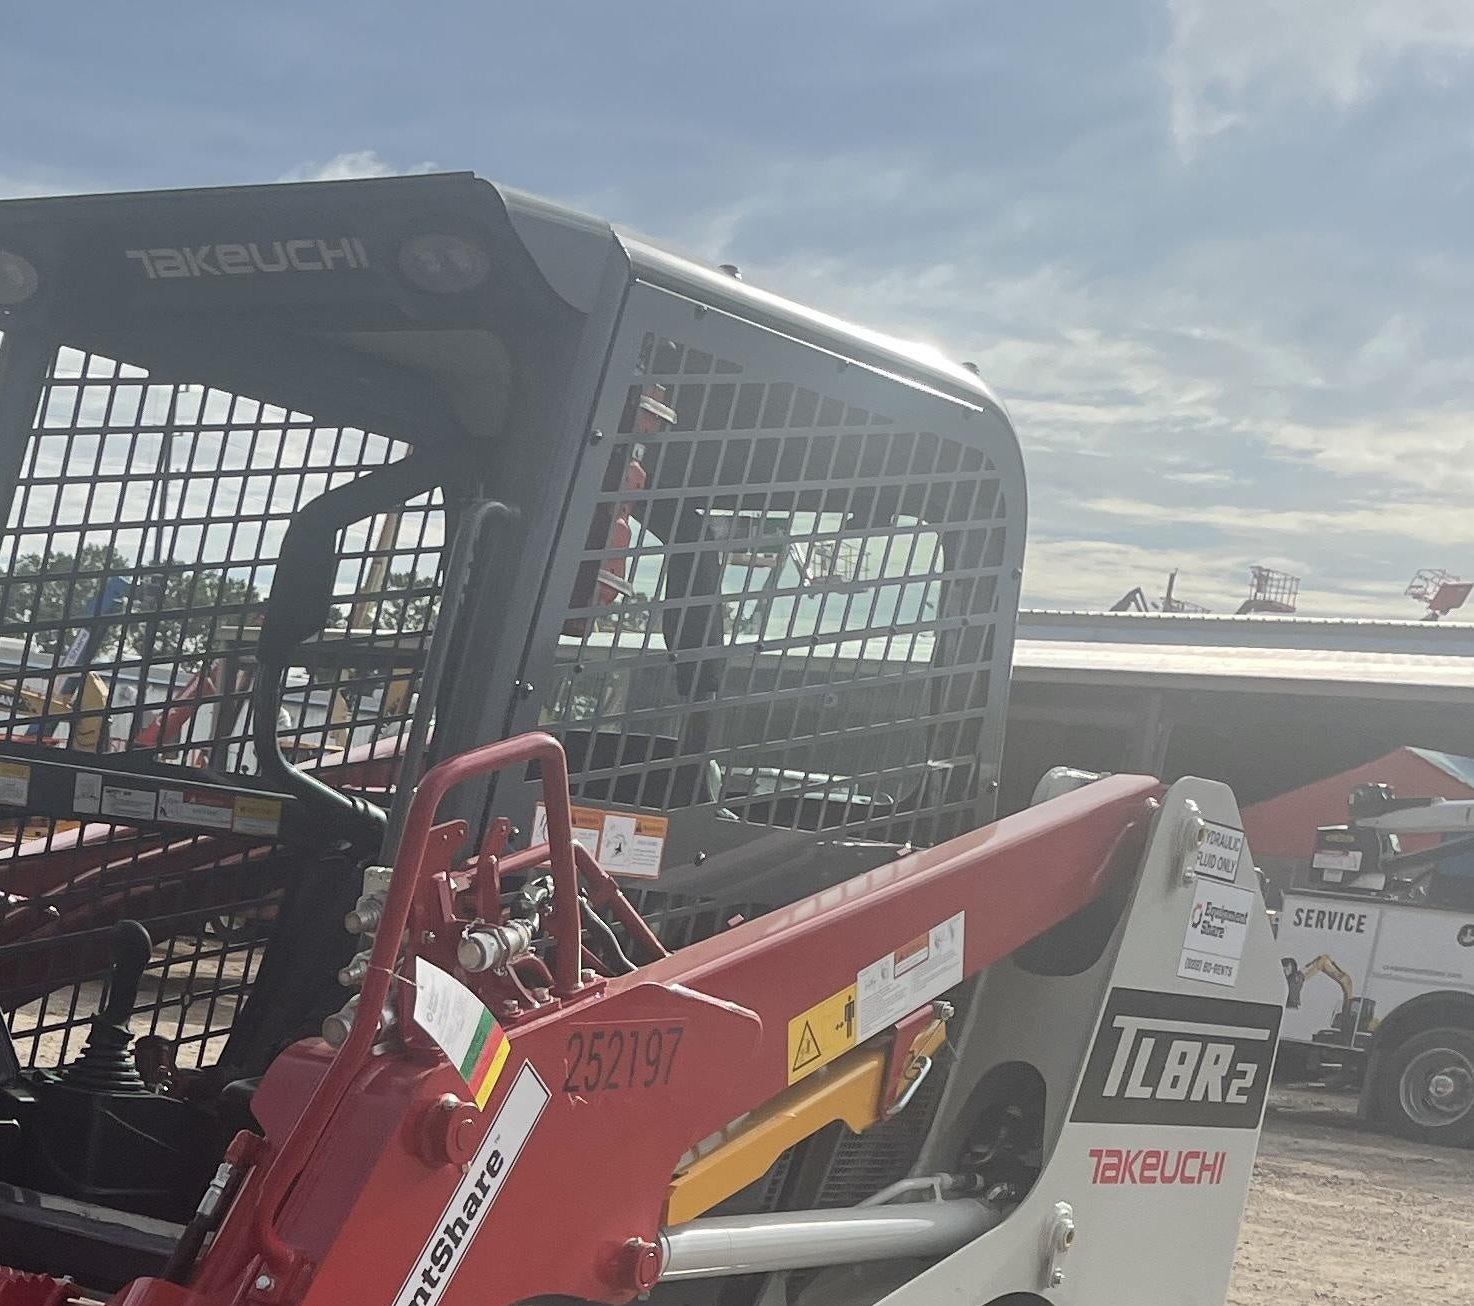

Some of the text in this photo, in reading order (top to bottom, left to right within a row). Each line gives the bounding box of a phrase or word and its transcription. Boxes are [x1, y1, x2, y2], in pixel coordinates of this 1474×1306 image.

[126, 237, 370, 279] TAKEUCHI
[1204, 828, 1241, 852] YDRAULIC
[1217, 856, 1236, 874] ONLY
[1293, 907, 1367, 934] SERVICE
[562, 1027, 683, 1092] 252197
[1102, 1015, 1270, 1104] TL8R2
[1089, 1149, 1226, 1184] TAKEUCHI
